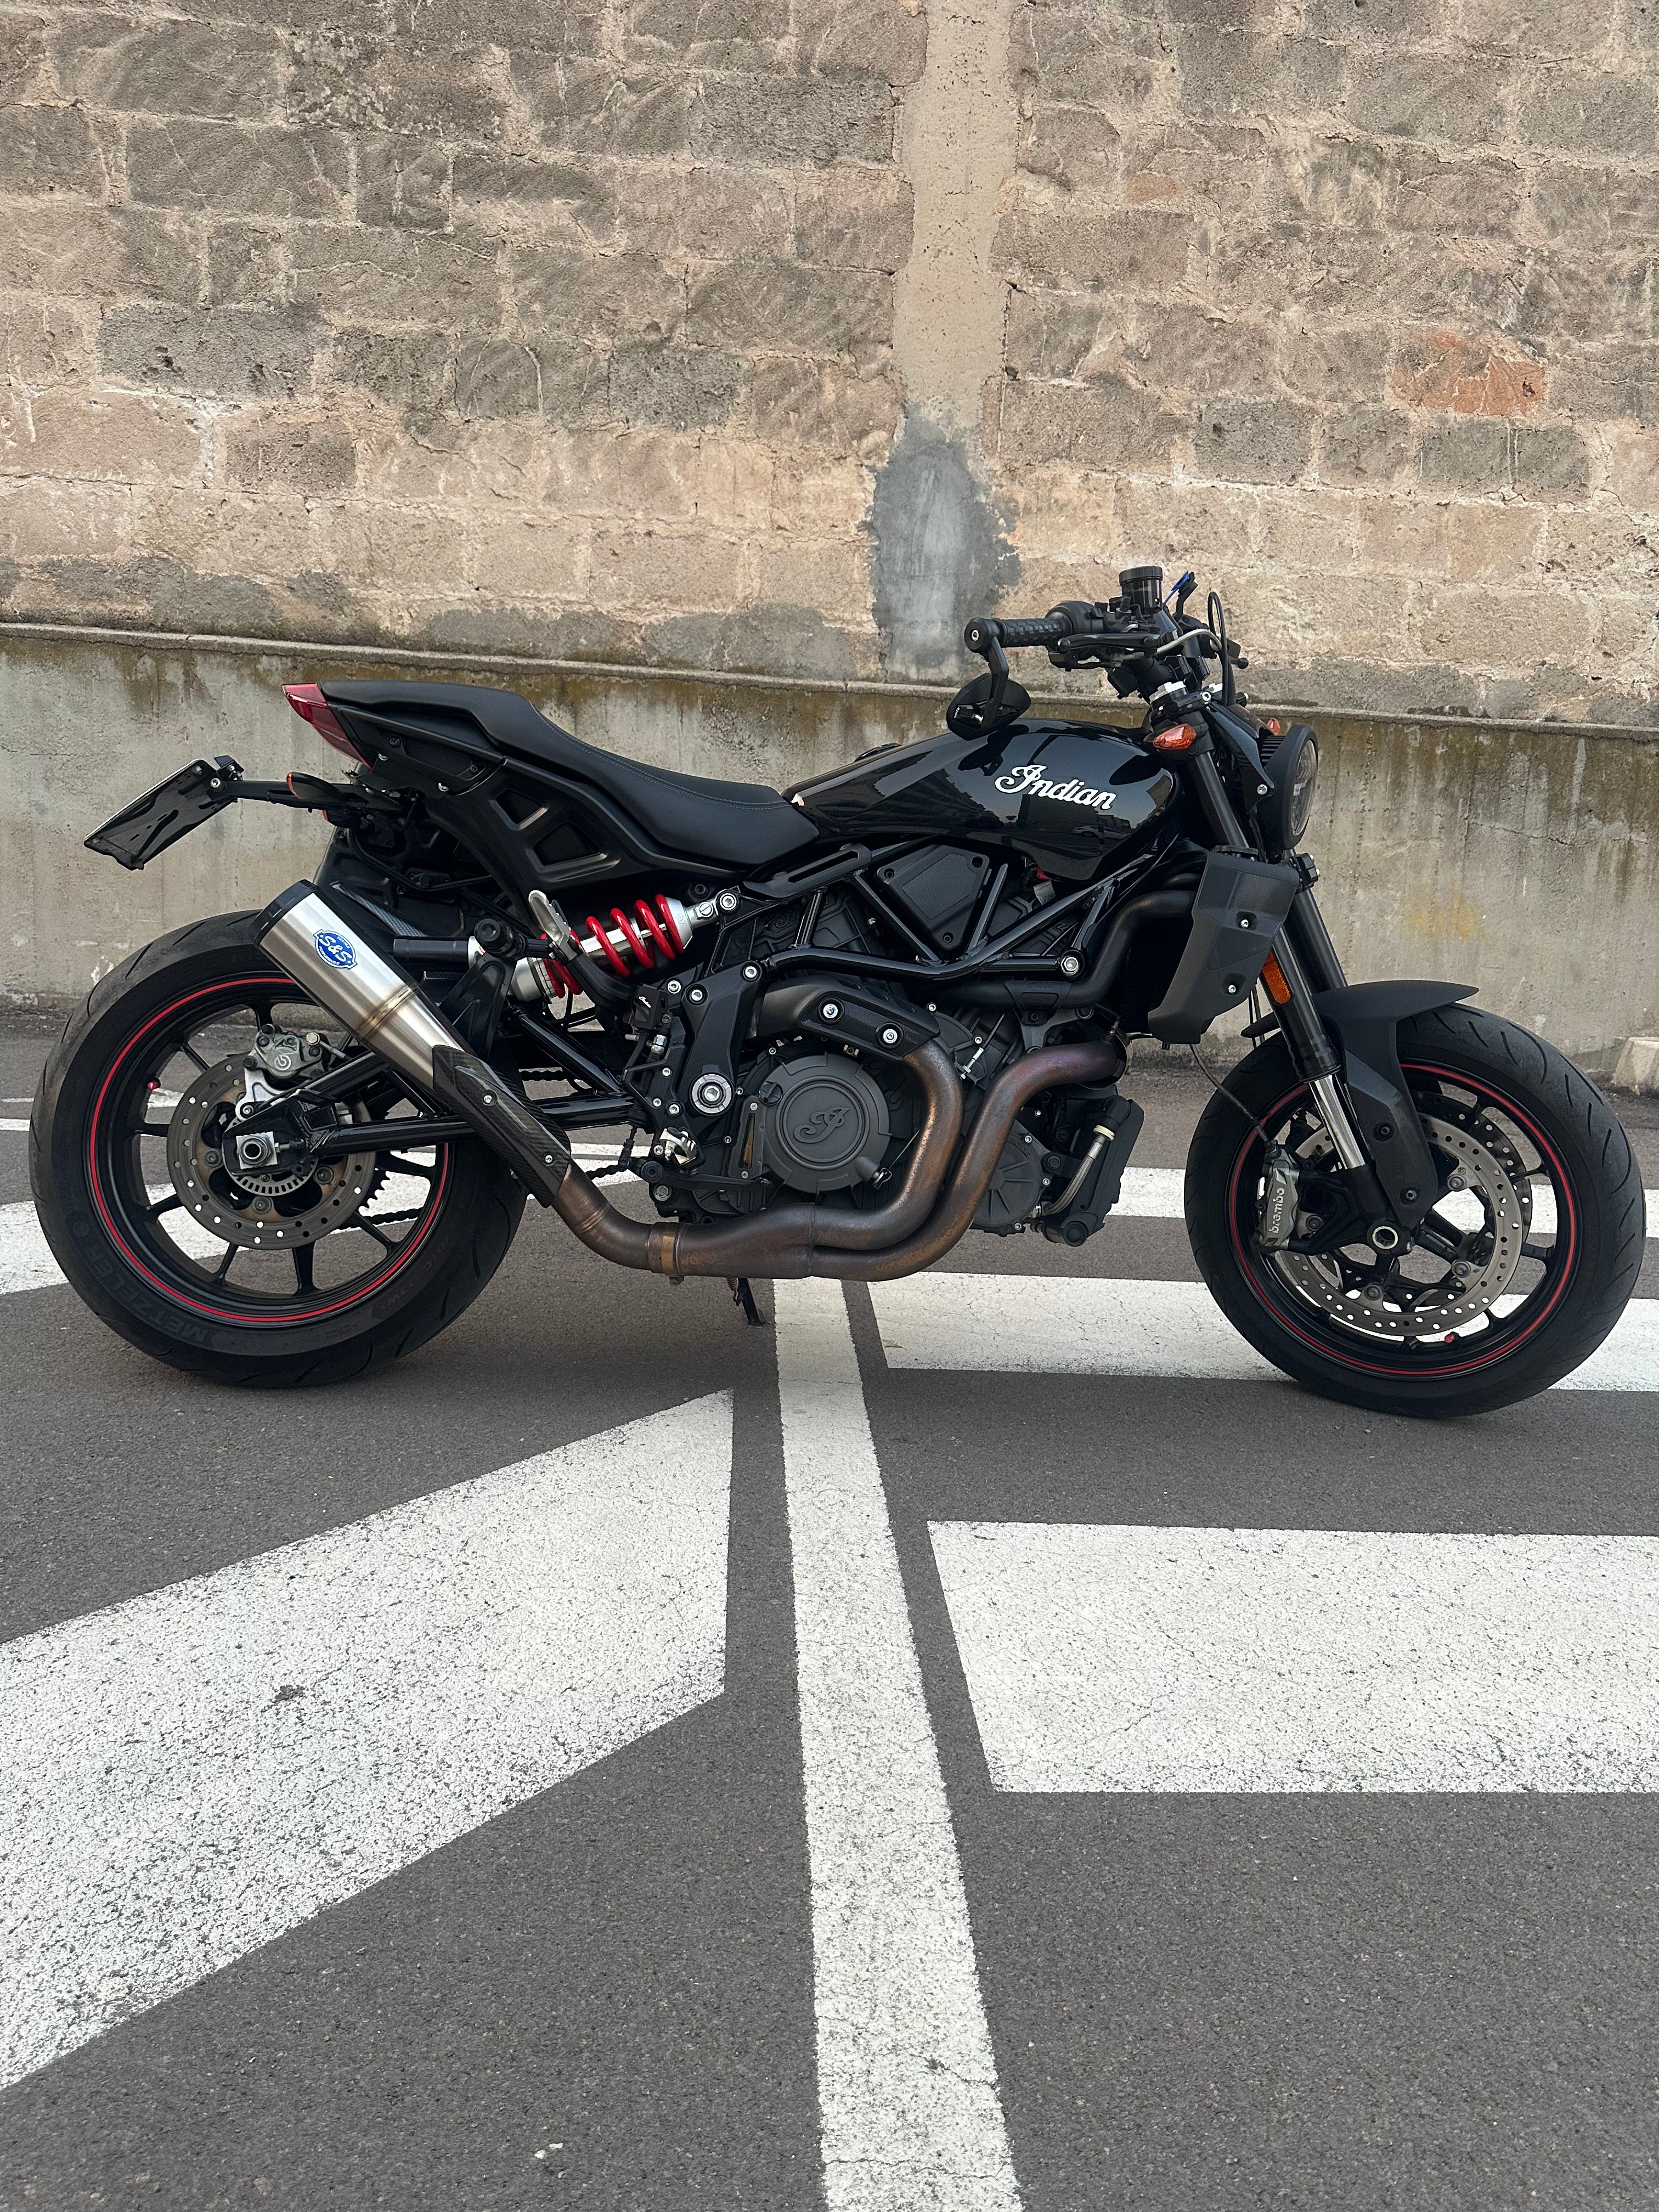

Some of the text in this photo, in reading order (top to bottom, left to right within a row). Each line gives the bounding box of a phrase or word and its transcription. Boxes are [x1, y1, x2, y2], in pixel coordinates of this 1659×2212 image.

[995, 765, 1116, 810] Indian
[319, 935, 352, 962] S&S
[1268, 1188, 1285, 1234] brembo
[84, 1245, 209, 1342] METZELER
